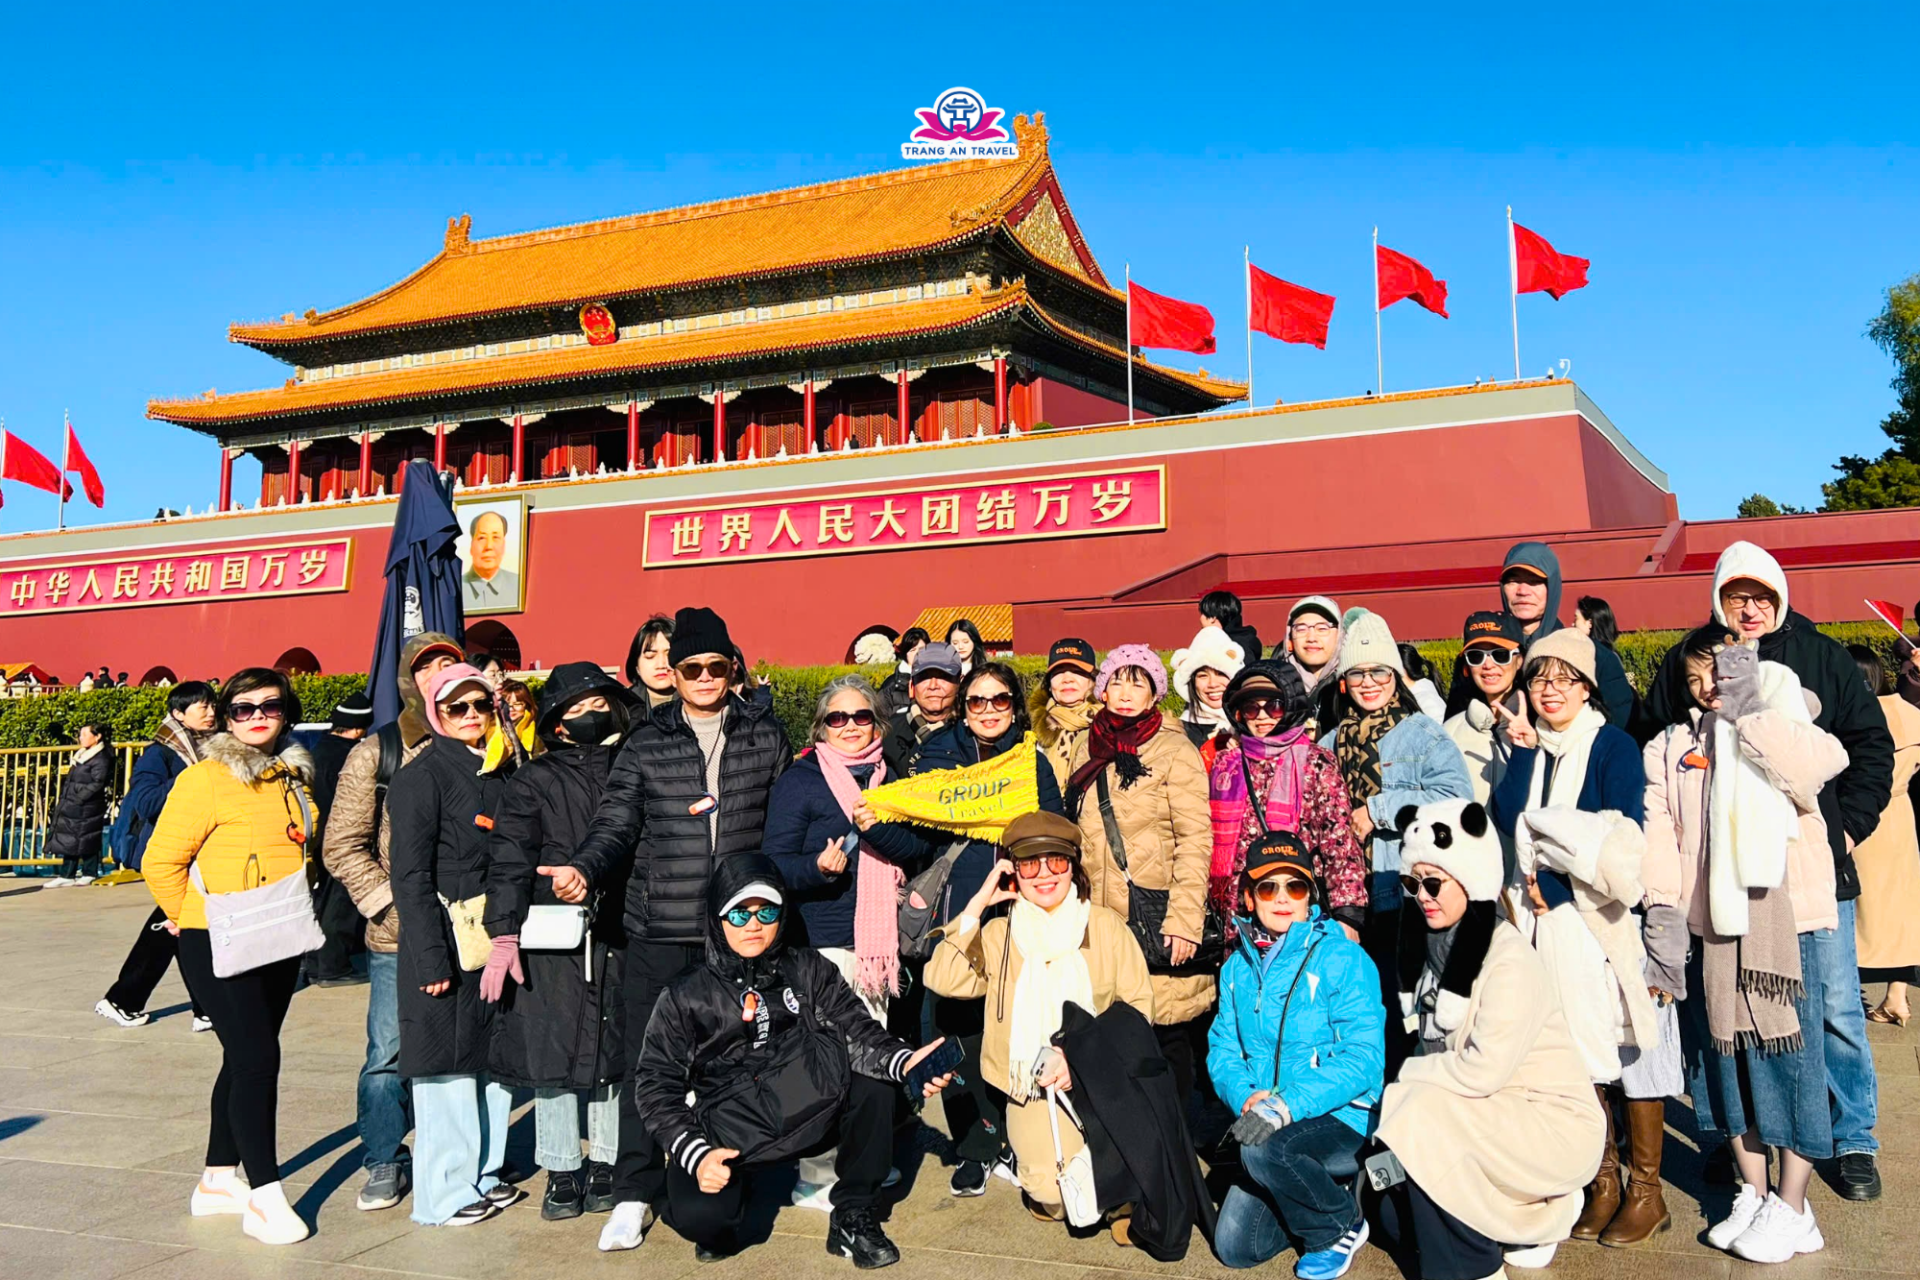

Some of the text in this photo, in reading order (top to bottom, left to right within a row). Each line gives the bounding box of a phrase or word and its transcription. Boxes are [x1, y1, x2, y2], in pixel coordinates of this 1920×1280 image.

[669, 480, 1133, 555] 世界人民大团结万岁
[10, 549, 328, 607] 中华人民共和国万岁
[939, 778, 1011, 805] GROUP
[1261, 846, 1293, 855] GROUP
